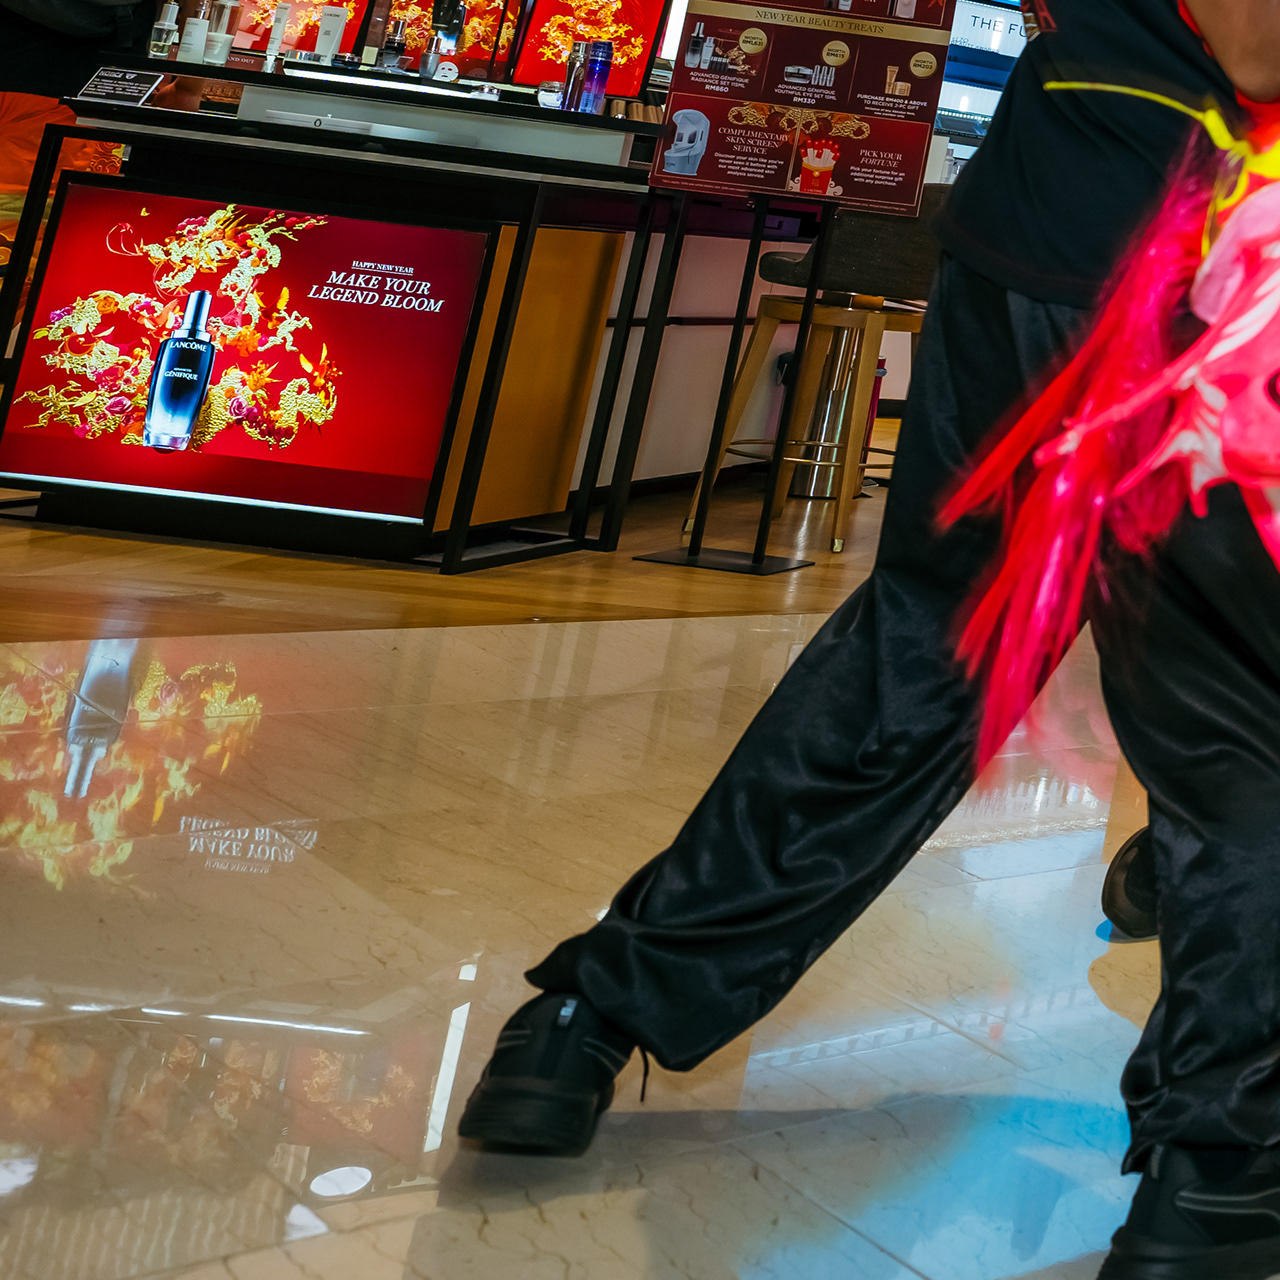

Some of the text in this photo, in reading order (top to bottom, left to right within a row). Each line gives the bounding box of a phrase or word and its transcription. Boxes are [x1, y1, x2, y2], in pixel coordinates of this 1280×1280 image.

[755, 10, 885, 34] NEW YEAR BEAUTY TREATS
[971, 14, 1005, 33] THE
[689, 71, 720, 80] ADVANCED
[690, 76, 719, 85] RADIANCE
[704, 84, 730, 93] RM860
[777, 84, 807, 92] ADVANCED
[792, 96, 816, 105] RM330
[857, 93, 885, 102] PURCHASE
[717, 126, 791, 142] COMPLIMENTARY
[725, 135, 780, 148] SKIN SCREEN
[732, 144, 768, 155] SERVICE
[859, 149, 903, 161] PICK YOUR
[714, 151, 736, 160] Discover
[860, 156, 900, 168] FORTUNE
[352, 260, 414, 274] HAPPY NEW YEAR
[326, 270, 431, 295] MAKE YOUR
[307, 284, 445, 313] LEGEND BLOOM
[169, 341, 208, 352] LANCÔME
